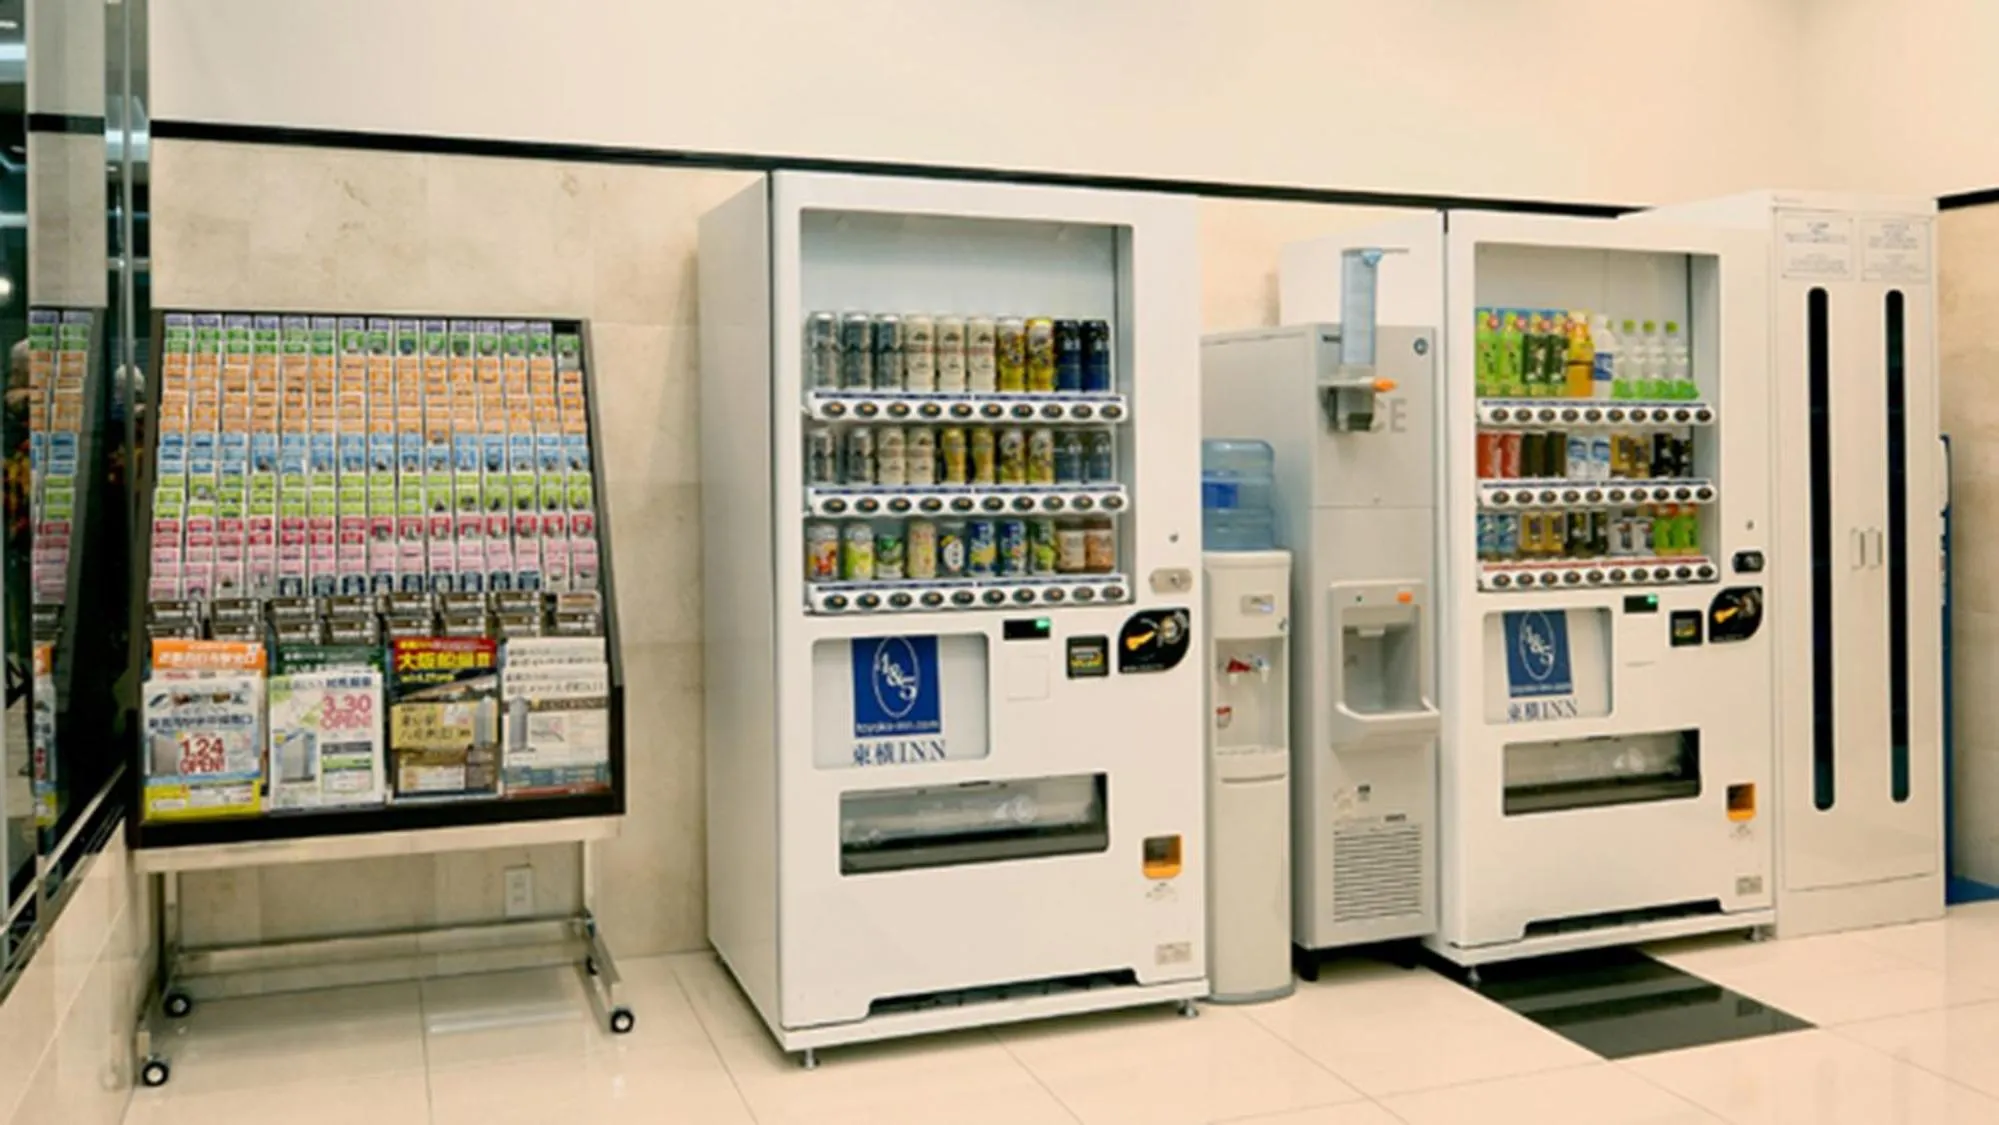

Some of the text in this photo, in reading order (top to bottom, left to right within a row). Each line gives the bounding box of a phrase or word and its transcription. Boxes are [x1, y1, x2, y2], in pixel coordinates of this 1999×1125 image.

[322, 693, 372, 716] 3.30
[1508, 698, 1578, 723] 東横INN
[181, 737, 224, 759] 1.24
[852, 740, 946, 767] 東横INN
